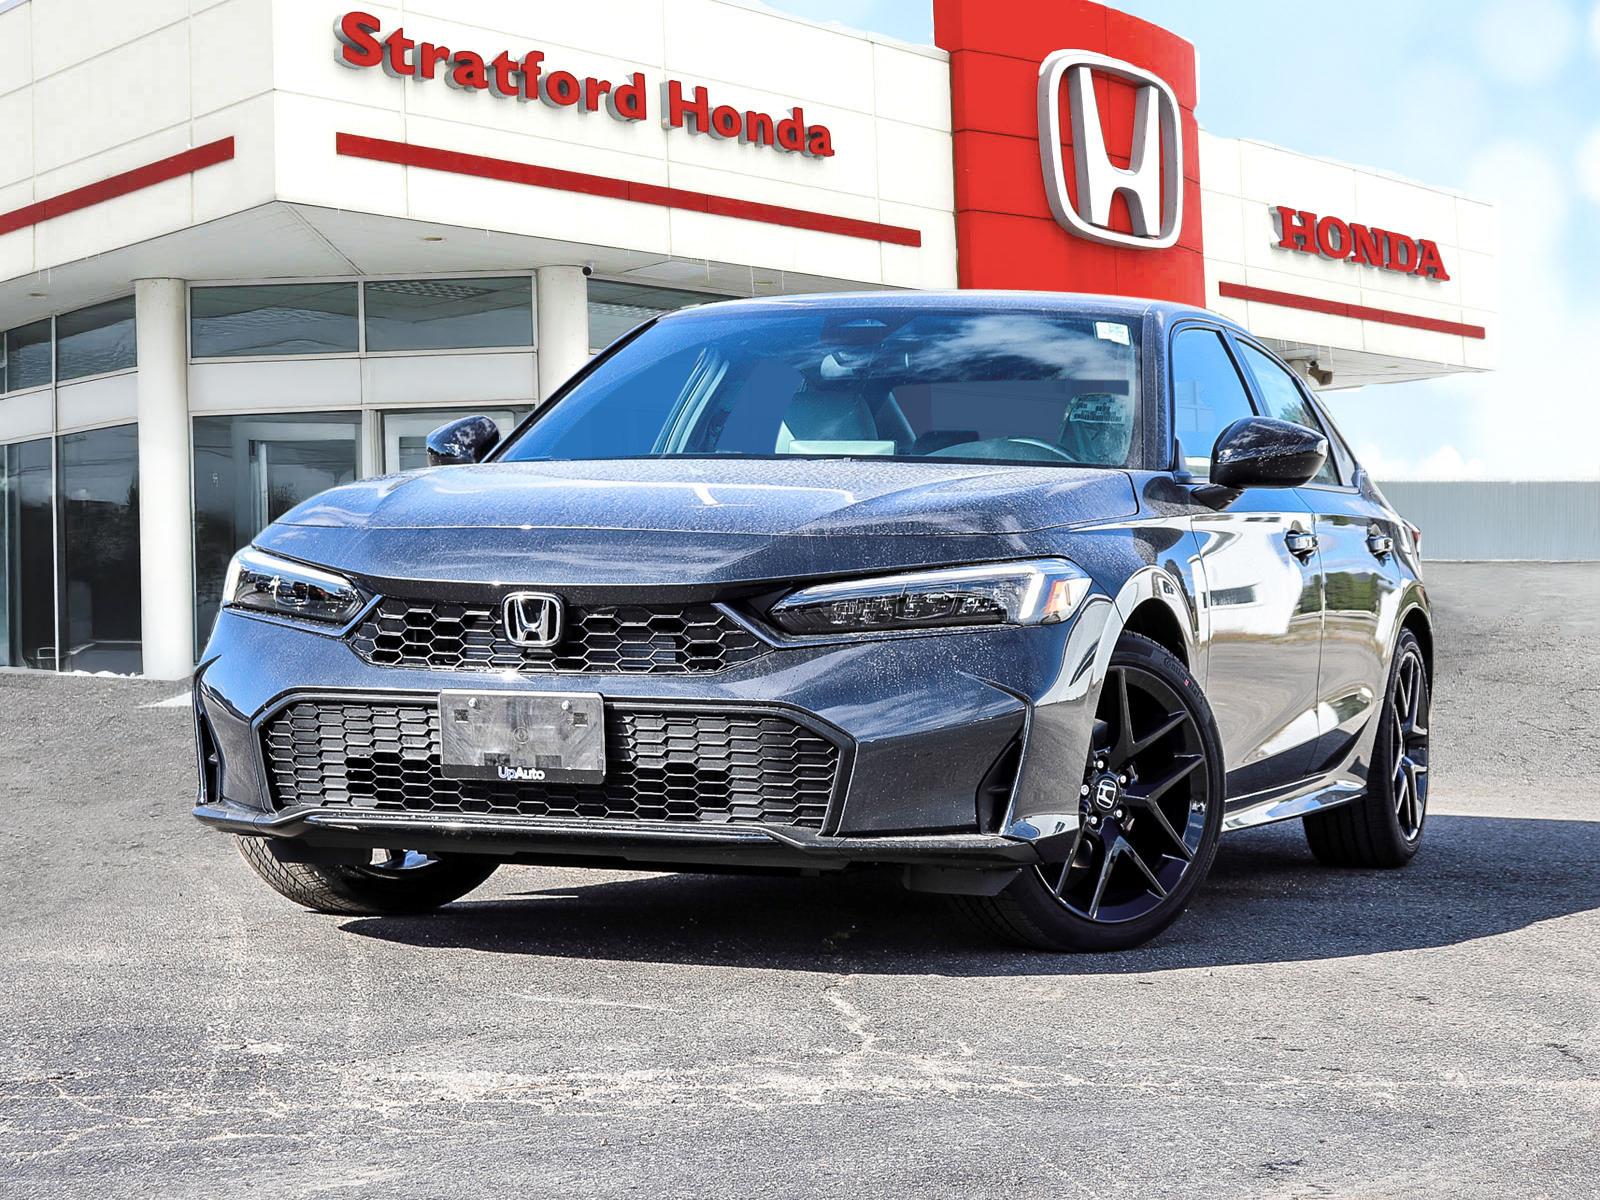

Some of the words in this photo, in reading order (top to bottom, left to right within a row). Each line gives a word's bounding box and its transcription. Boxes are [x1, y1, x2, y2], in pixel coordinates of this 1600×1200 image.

[338, 11, 647, 121] Stratford
[665, 79, 835, 158] Honda
[1274, 205, 1450, 281] HONDA
[498, 765, 546, 781] UpAuto
